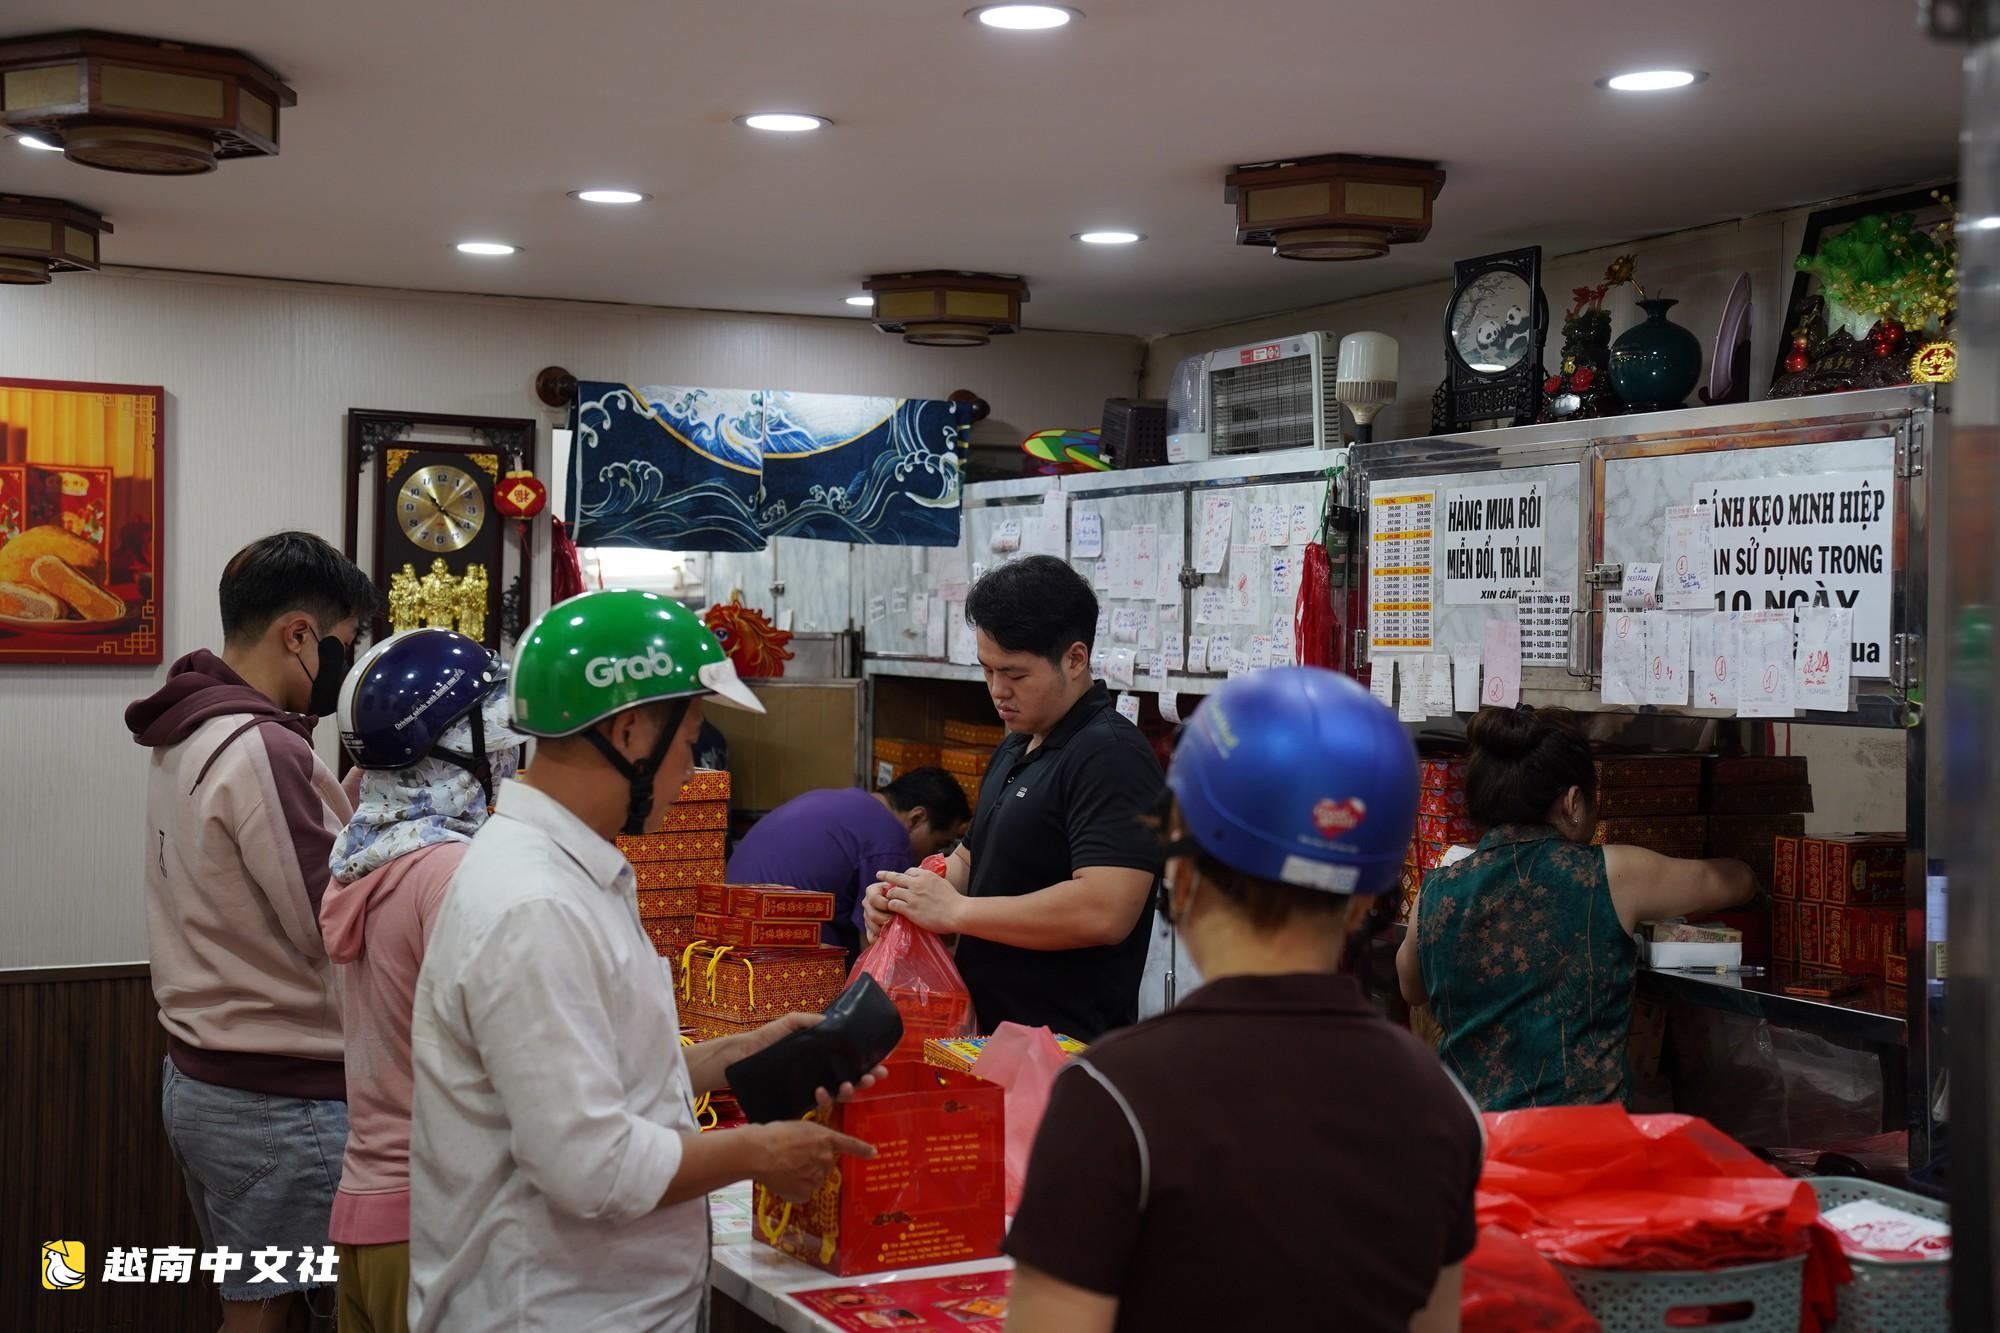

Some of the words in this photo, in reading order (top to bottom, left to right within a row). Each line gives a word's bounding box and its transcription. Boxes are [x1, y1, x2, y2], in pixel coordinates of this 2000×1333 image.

[464, 490, 472, 499] 2
[1448, 494, 1482, 532] HÀNG
[1486, 498, 1514, 530] MUA
[1518, 484, 1541, 528] RỒI
[1699, 489, 1745, 528] ÁNH
[1748, 495, 1784, 533] KẸO
[1788, 492, 1834, 525] MINH
[1839, 480, 1885, 531] HIỆP
[436, 536, 444, 544] 6
[1447, 537, 1473, 580] MIỄN
[1476, 534, 1497, 583] ĐỔI,
[1500, 536, 1520, 578] TRẢ
[1524, 546, 1541, 586] LẠI
[1736, 537, 1760, 575] SỬ
[1764, 546, 1812, 580] DỤNG
[1818, 544, 1882, 575] TRONG
[1480, 590, 1497, 599] XIN
[1519, 594, 1532, 604] BÁNH
[1537, 595, 1554, 604] TRỨNG
[1560, 595, 1570, 606] KẸO
[1714, 590, 1752, 612] 10
[1766, 580, 1860, 615] NGÀY
[585, 646, 673, 688] Grab
[1852, 642, 1880, 662] ua
